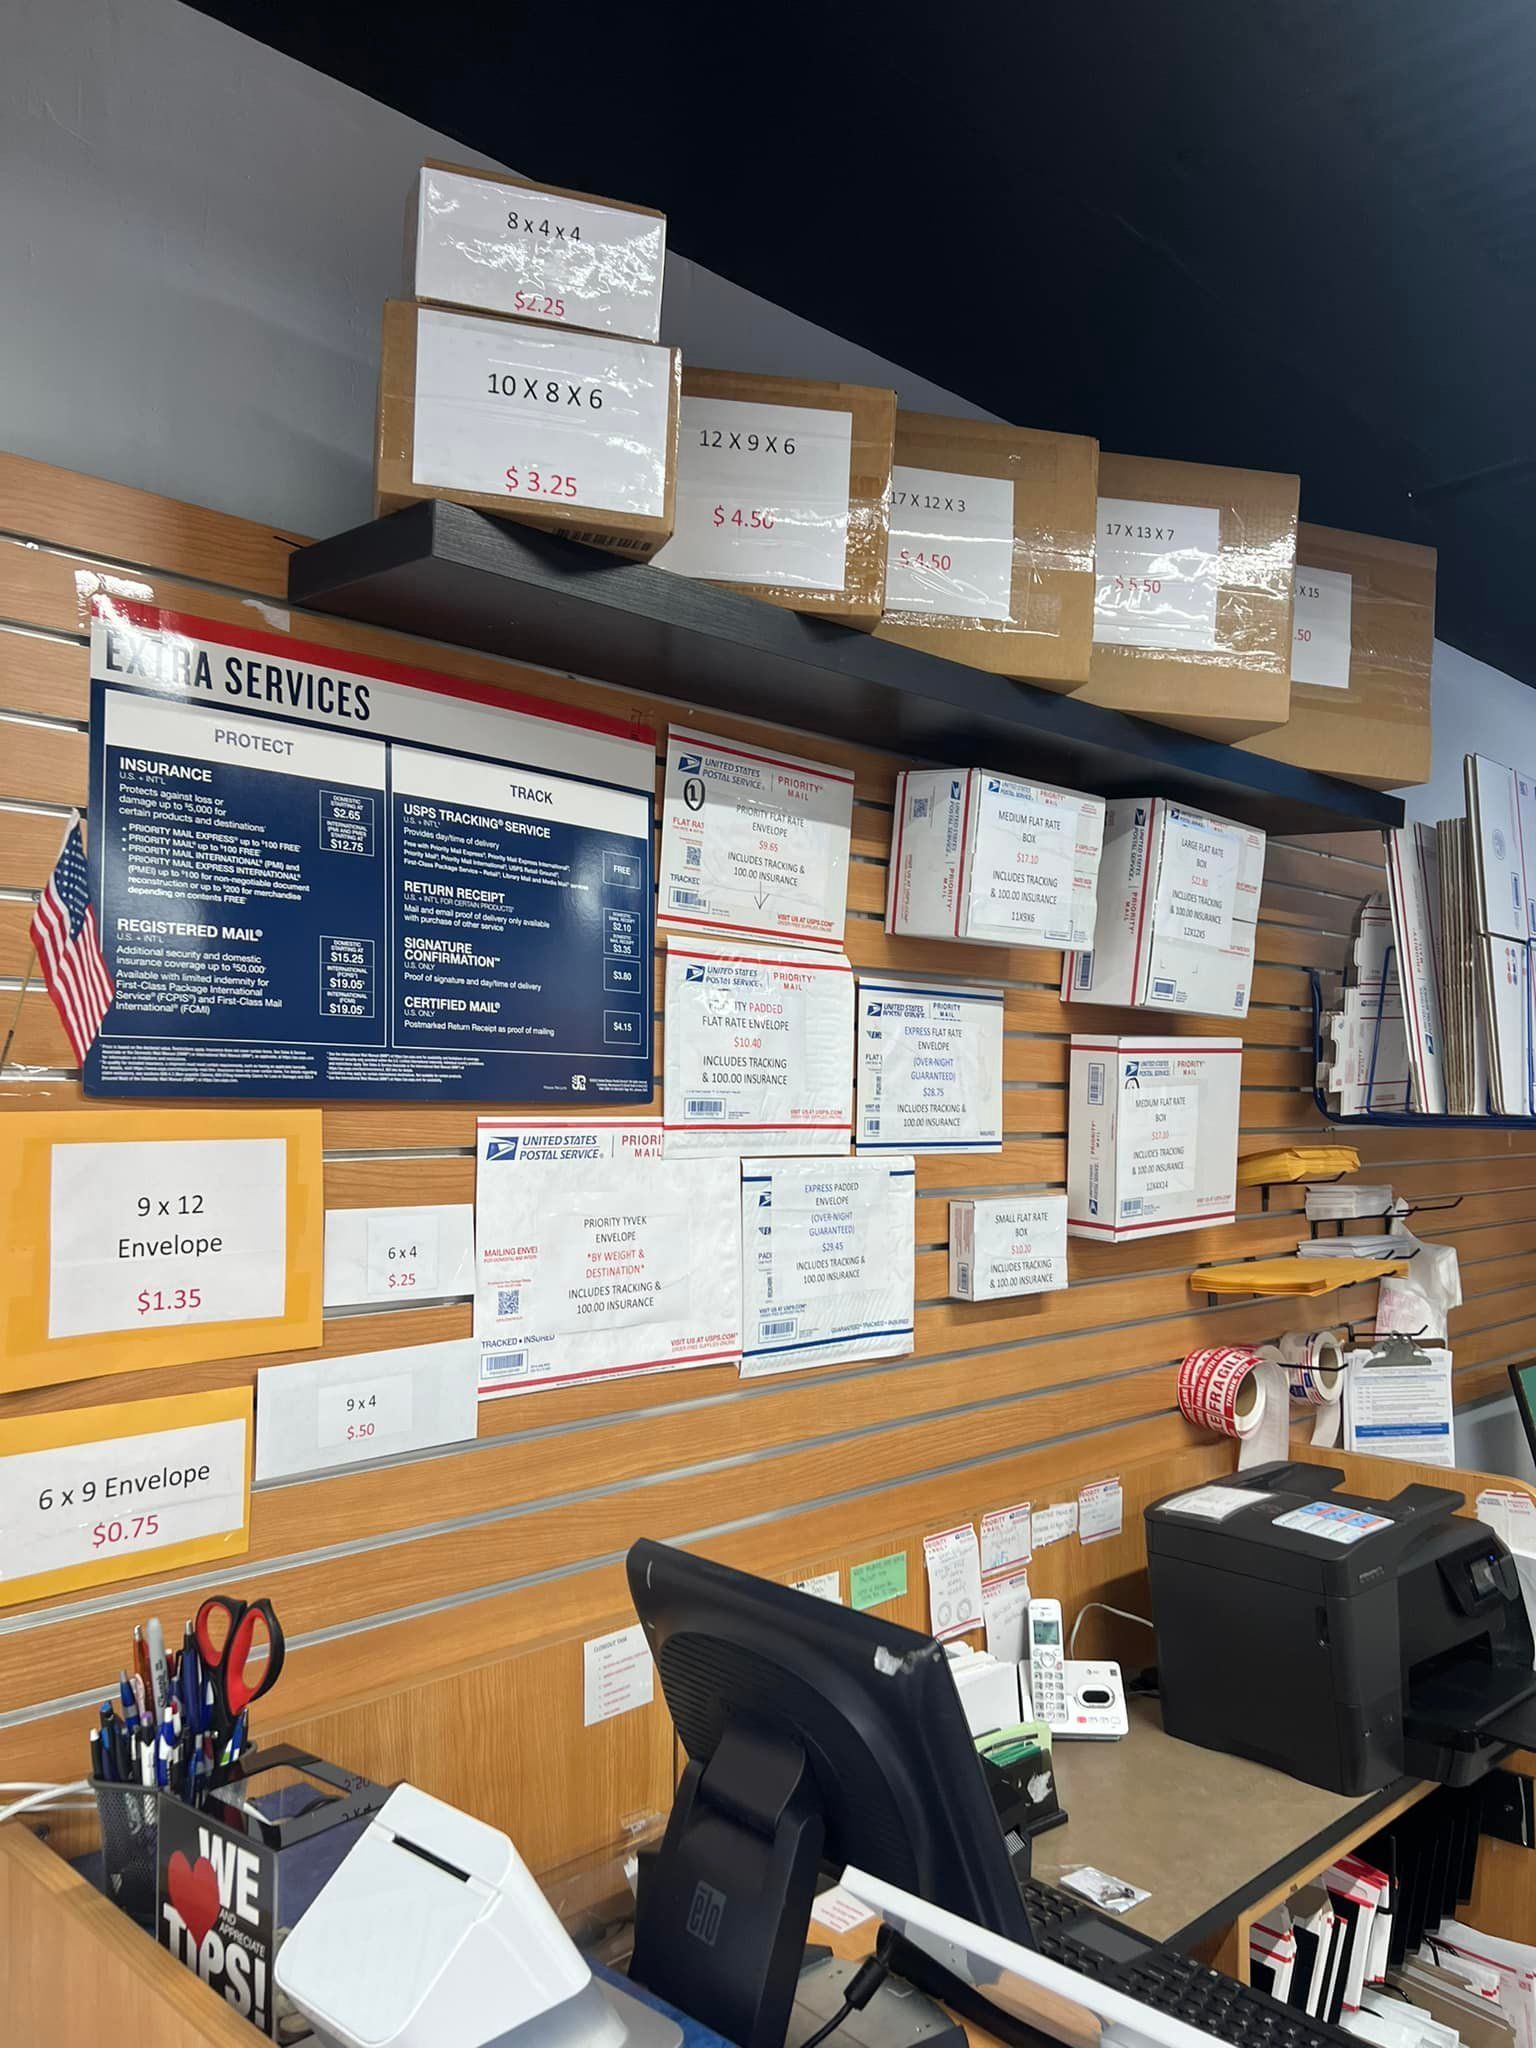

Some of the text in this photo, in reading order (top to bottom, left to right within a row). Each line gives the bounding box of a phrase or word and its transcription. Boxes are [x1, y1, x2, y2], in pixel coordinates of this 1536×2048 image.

[507, 211, 581, 241] 8 x 4 x 4
[514, 291, 566, 317] $2.25
[487, 373, 603, 410] 10 X 8 X 6
[699, 430, 796, 455] 12 X 9 X 6
[527, 471, 578, 497] 3.25
[890, 491, 966, 512] 17 X 12 X 3
[1105, 522, 1175, 542] 17 X 13 X 7
[1310, 587, 1320, 599] 15
[1294, 629, 1312, 642] .50
[106, 630, 371, 721] EXTRA SERVICES
[214, 728, 295, 756] PROTECT
[119, 757, 212, 783] INSURANCE
[704, 757, 760, 778] UNITED STATES
[702, 768, 761, 790] POSTAL SERVICE
[119, 784, 224, 806] Protects against loss or
[510, 784, 553, 805] TRACK
[787, 789, 809, 801] MAIL
[333, 808, 361, 821] $2.65
[404, 803, 436, 819] USPS
[505, 820, 551, 839] SERVICE
[672, 817, 692, 828] FLAT
[736, 804, 804, 828] PRIORITY FLAT RATE
[998, 810, 1061, 831] MEDIUM FLAT RATE
[752, 822, 788, 838] ENVELOPE
[1022, 832, 1036, 845] BOX
[330, 838, 364, 852] $12.75
[613, 865, 631, 876] FREE
[727, 851, 763, 866] INCLUDES
[764, 858, 799, 873] TRACKING
[733, 866, 798, 887] 100.00 INSURANCE
[404, 880, 505, 905] RETURN RECEIPT
[117, 918, 218, 938] REGISTERED
[613, 921, 632, 933] $2.10
[404, 937, 472, 955] SIGNATURE
[613, 943, 632, 955] $3.35
[330, 952, 364, 965] $15.25
[404, 996, 466, 1012] CERTIFIED
[749, 1002, 783, 1015] PADDED
[404, 1020, 498, 1035] Postmarked Return Receipt
[613, 1020, 632, 1032] $4.15
[702, 1016, 790, 1032] FLAT RATE ENVELOPE
[734, 1036, 762, 1049] $10.40
[918, 1041, 949, 1051] ENVELOPE
[703, 1055, 787, 1069] INCLUDES TRACKING
[702, 1072, 788, 1086] & 100.00 INSURANCE
[521, 1134, 598, 1147] UNITED STATES
[519, 1148, 600, 1161] POSTAL SERVICE
[634, 1147, 662, 1158] MAIL
[805, 1182, 859, 1193] EXPRESS PADDED
[137, 1195, 205, 1217] 9 x 12
[815, 1196, 849, 1206] ENVELOPE
[584, 1215, 647, 1228] PRIORITY TYVEK
[995, 1212, 1049, 1224] SMALL FLAT RATE
[595, 1231, 637, 1244] ENVELOPE
[1016, 1228, 1028, 1238] BOX
[118, 1235, 223, 1260] Envelope
[388, 1245, 418, 1259] 6 x 4
[484, 1247, 515, 1258] MAILING
[605, 1249, 636, 1262] WEIGHT
[638, 1248, 645, 1259] &
[388, 1272, 416, 1289] $.25
[568, 1281, 662, 1300] INCLUDES TRACKING &
[136, 1288, 202, 1316] $1.35
[577, 1297, 655, 1315] 100.00 INSURANCE
[481, 1337, 518, 1349] TRACKED
[1210, 1352, 1245, 1412] FRAGILE
[1226, 1377, 1238, 1408] THANK
[346, 1395, 377, 1412] 9 x 4
[346, 1423, 375, 1440] $.50
[38, 1463, 211, 1510] 6 x 9 Envelope
[92, 1515, 159, 1549] $0.75
[198, 1827, 260, 1926] WE
[220, 1910, 238, 1925] AND
[218, 1922, 266, 1957] APPRECIATE
[162, 1902, 267, 2032] TIPS!
